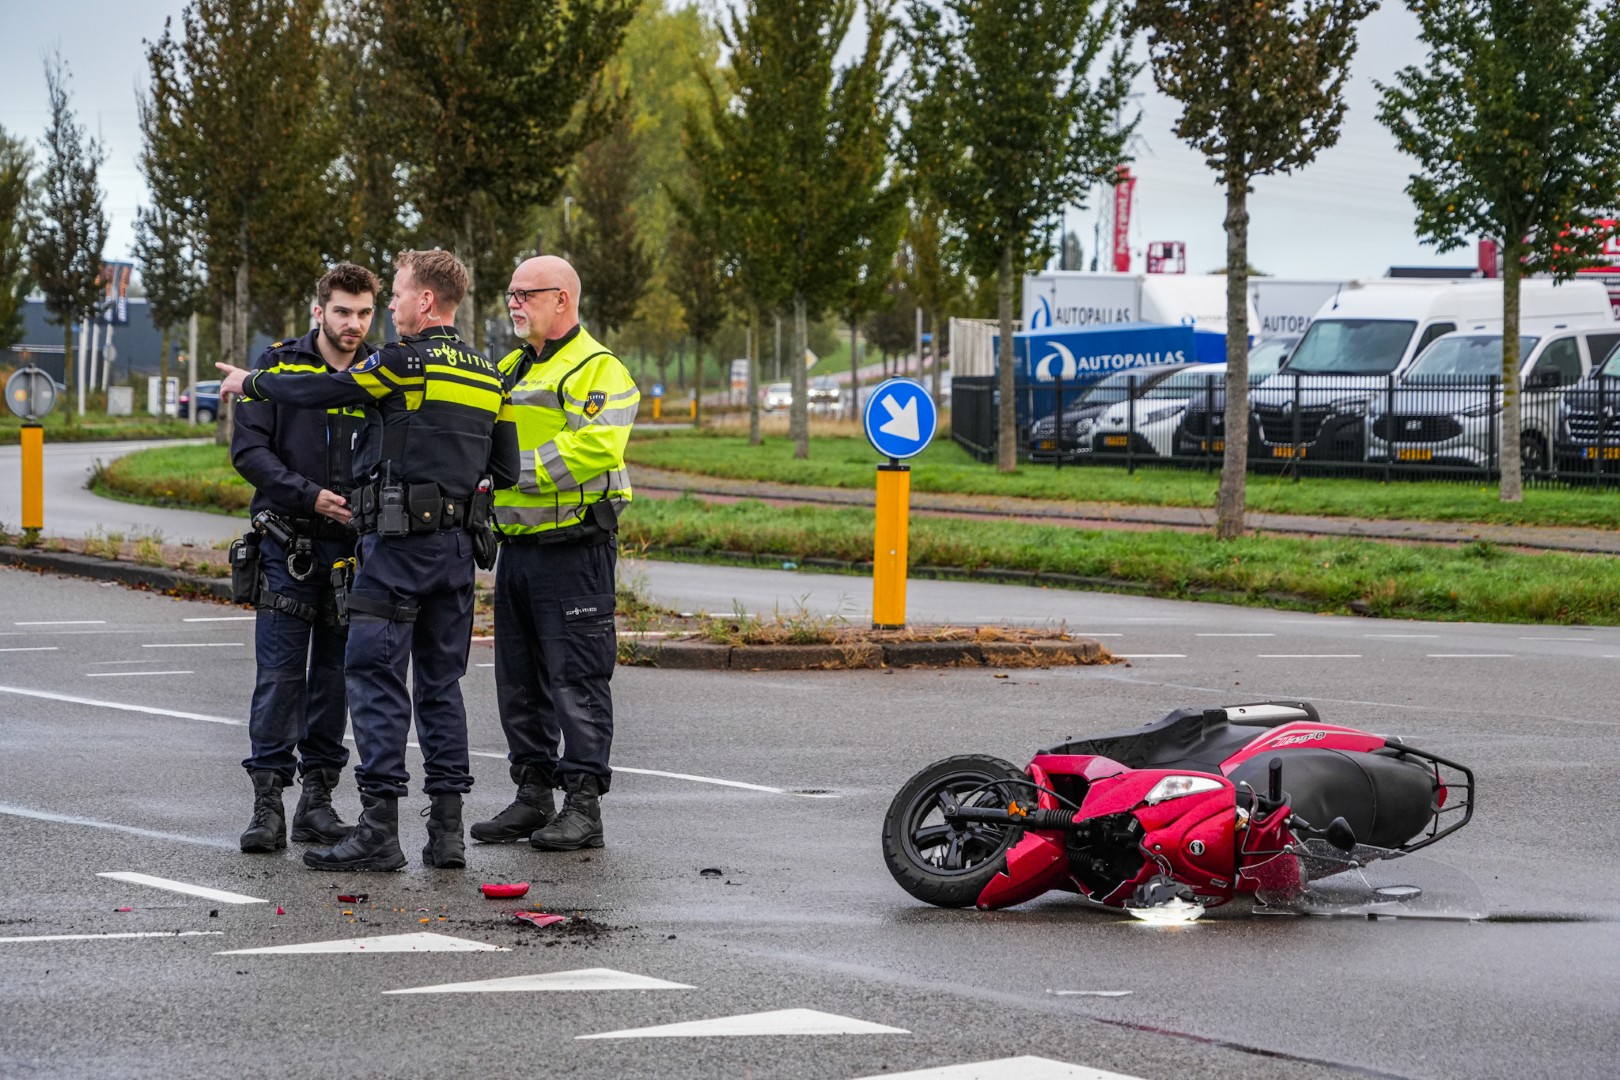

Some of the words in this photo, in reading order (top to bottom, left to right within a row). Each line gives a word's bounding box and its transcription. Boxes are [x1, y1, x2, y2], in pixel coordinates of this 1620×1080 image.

[1056, 307, 1130, 325] AUTOPALLAS
[1263, 315, 1312, 333] AUTOPA
[432, 342, 495, 373] POLITIE
[1078, 350, 1185, 371] AUTOPALLAS
